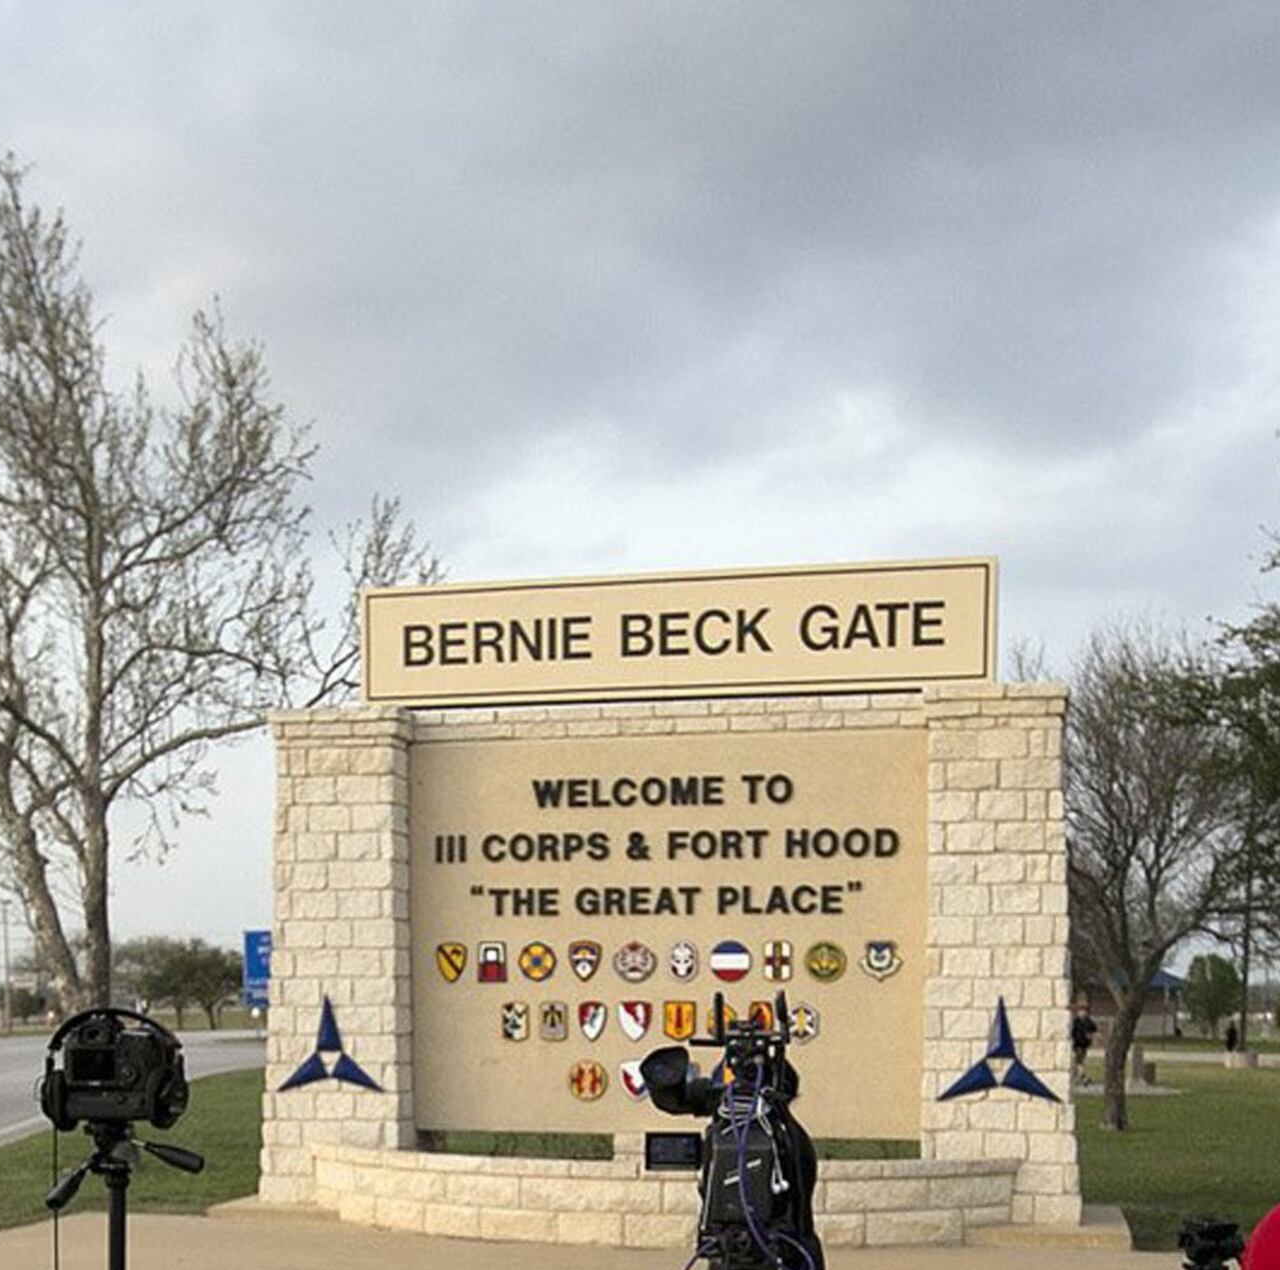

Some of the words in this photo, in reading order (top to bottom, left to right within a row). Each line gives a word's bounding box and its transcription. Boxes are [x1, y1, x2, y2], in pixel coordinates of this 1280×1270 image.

[404, 616, 592, 667] BERNIE
[621, 608, 772, 658] BECK
[800, 601, 945, 651] GATE
[532, 776, 725, 809] WELCOME
[741, 774, 794, 805] TO
[434, 834, 467, 865] III
[481, 832, 611, 863] CORPS
[625, 831, 651, 861] &
[667, 829, 770, 861] FORT
[785, 828, 900, 859] HOOD
[574, 886, 702, 917] GREAT
